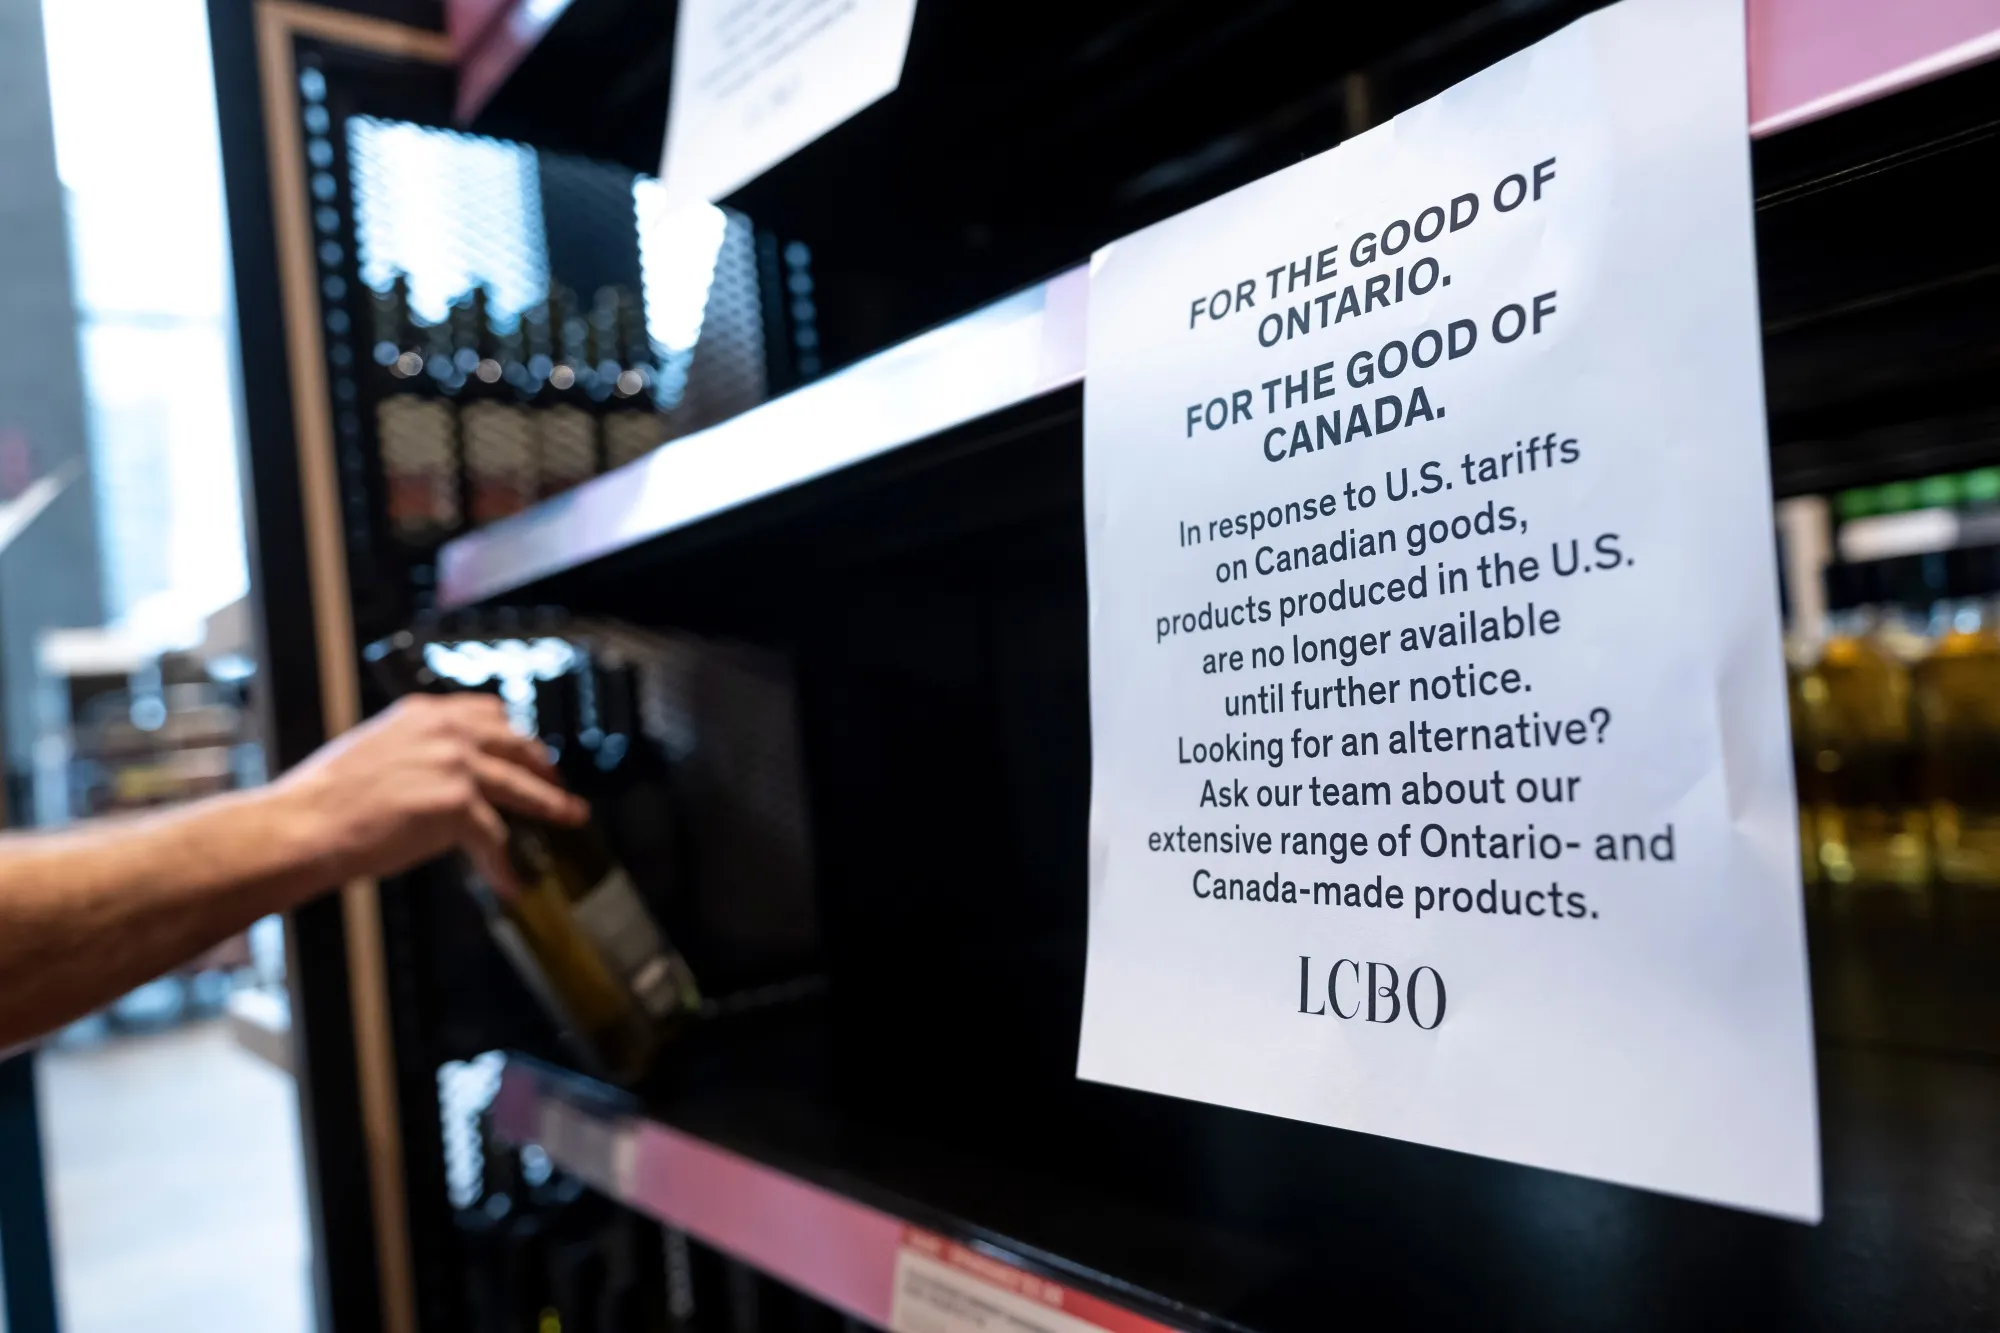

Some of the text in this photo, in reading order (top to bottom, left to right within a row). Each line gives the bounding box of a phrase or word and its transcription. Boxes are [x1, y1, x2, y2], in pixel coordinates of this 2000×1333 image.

[1189, 156, 1557, 330] FOR THE GOOD OF
[1257, 254, 1451, 348] ONTARIO.
[1186, 289, 1558, 439] FOR THE GOOD OF
[1263, 385, 1446, 463] CANADA.
[1179, 431, 1581, 548] In response to U.S. tariffs
[1215, 499, 1528, 584] on Canadian goods,
[1156, 532, 1635, 645] products produced in the U.S.
[1202, 601, 1561, 675] are no longer available
[1224, 662, 1532, 717] until further notice.
[1178, 706, 1612, 769] Looking for an alternative?
[1199, 769, 1582, 808] Ask our team about our
[1147, 823, 1676, 865] extensive range of Ontario- and
[1192, 868, 1599, 920] Canada-made products.
[1297, 955, 1447, 1031] LCBO
